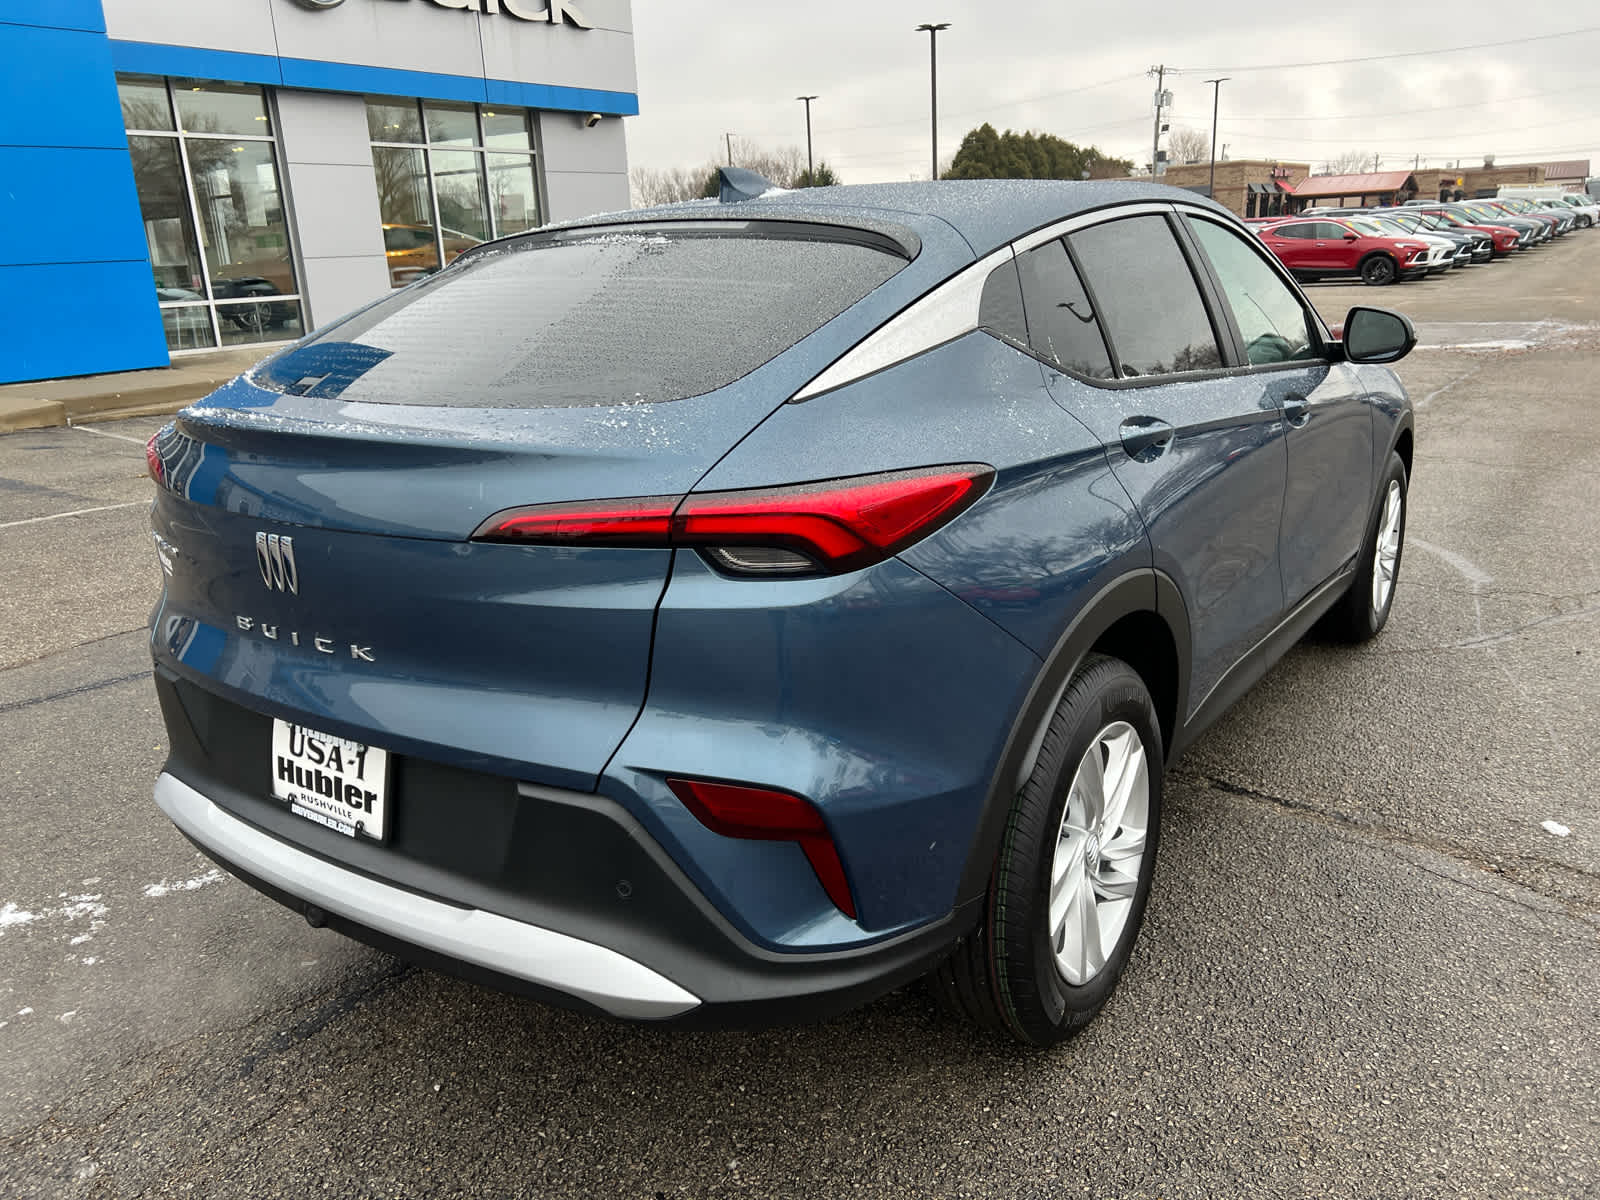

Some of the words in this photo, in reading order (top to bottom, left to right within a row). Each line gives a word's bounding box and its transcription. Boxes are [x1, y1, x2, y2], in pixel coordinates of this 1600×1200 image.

[236, 615, 376, 662] BUICK
[289, 724, 368, 781] USA-1
[277, 755, 377, 815] Hubler
[301, 793, 353, 820] RUSHVILLE
